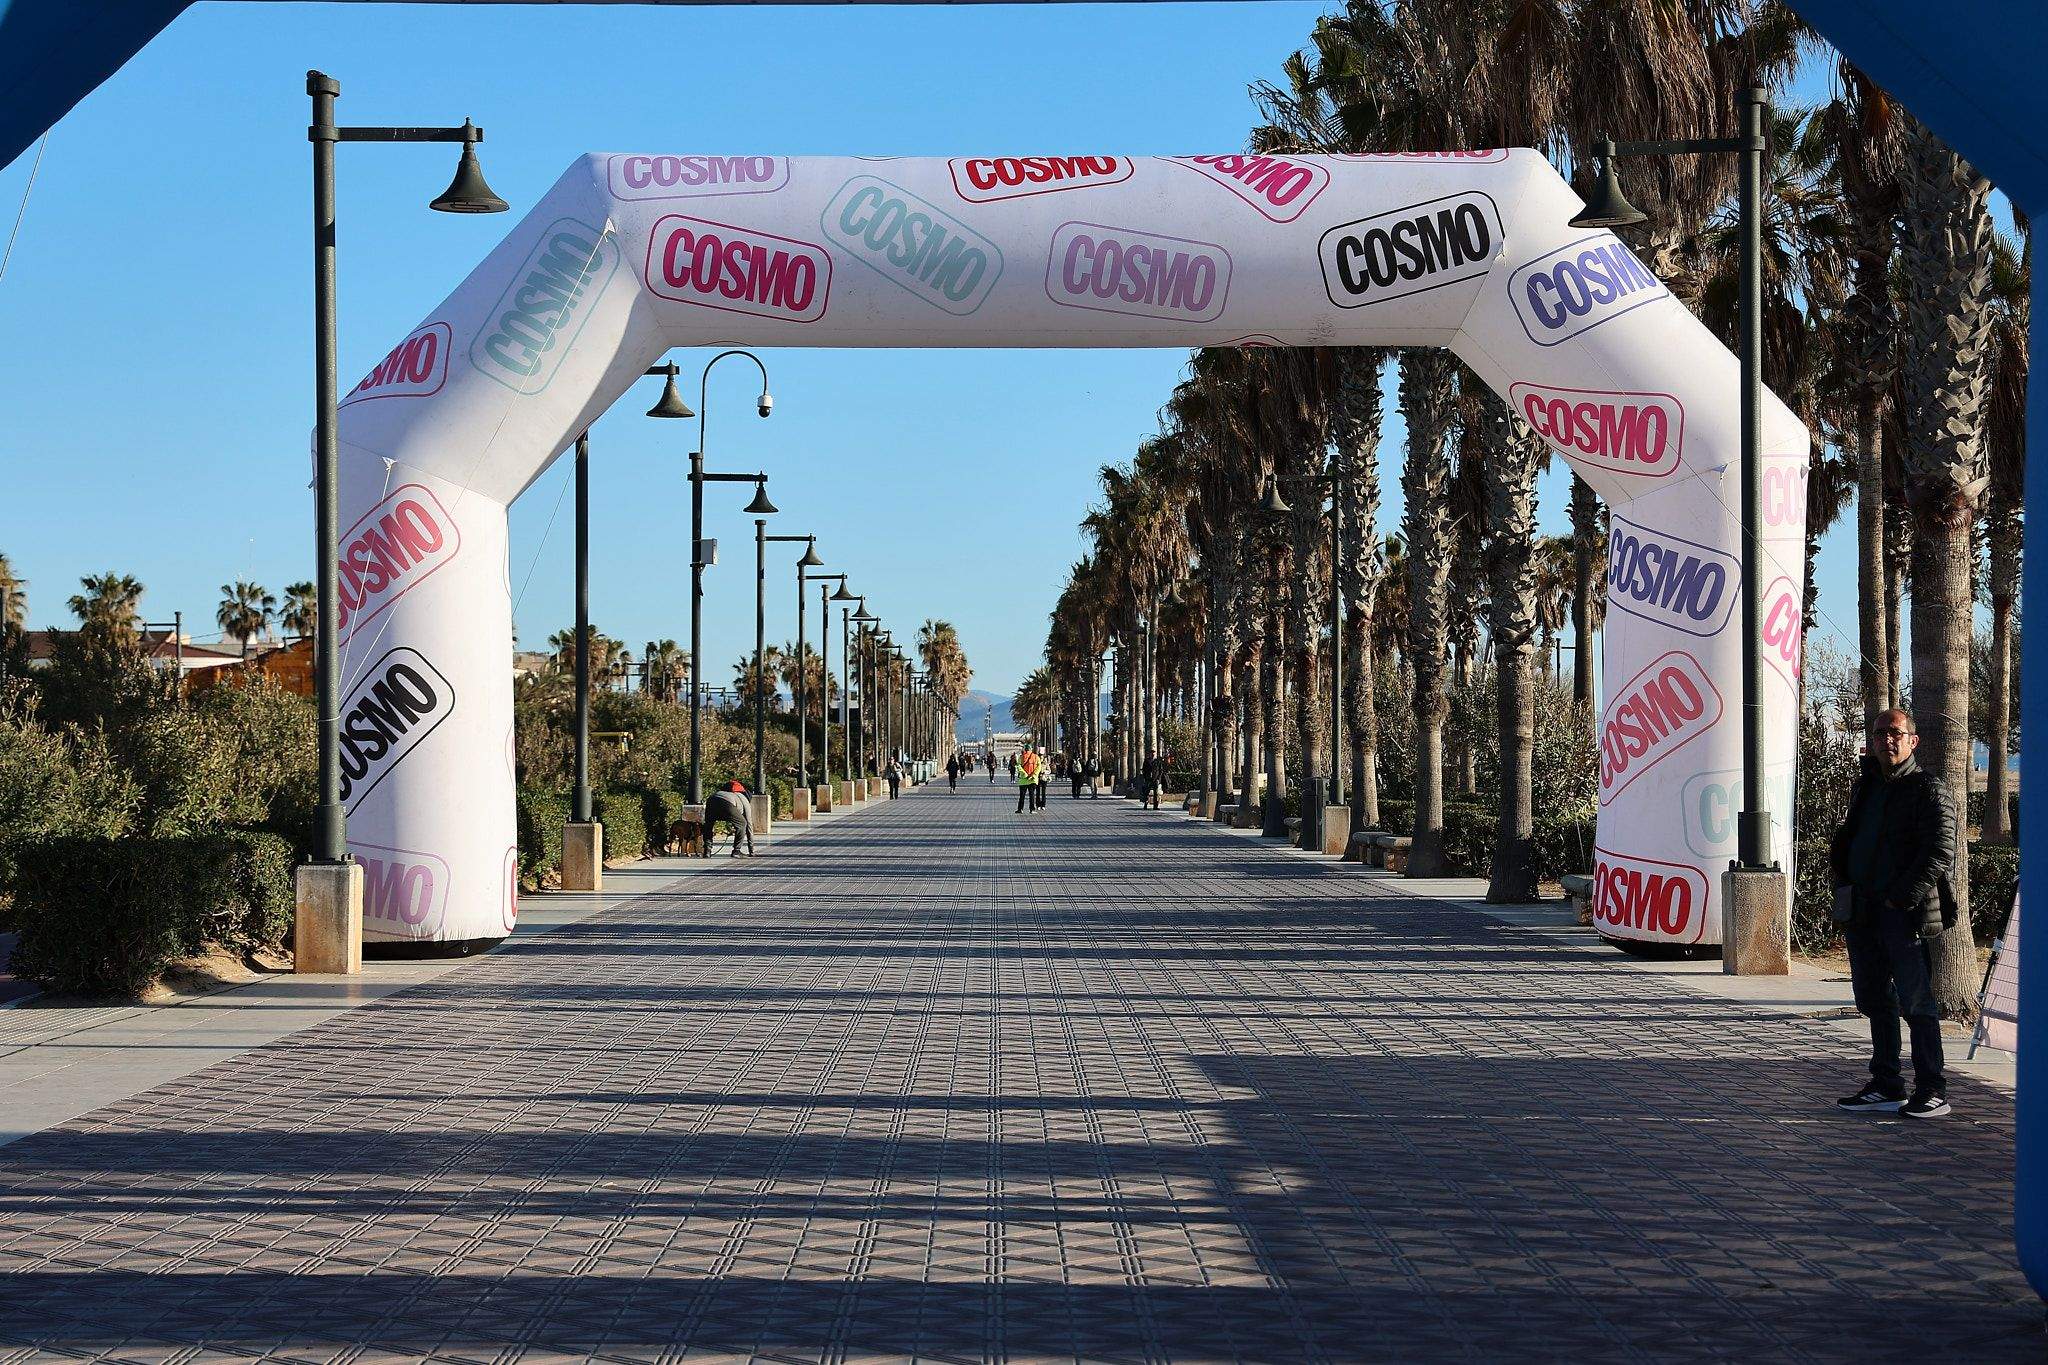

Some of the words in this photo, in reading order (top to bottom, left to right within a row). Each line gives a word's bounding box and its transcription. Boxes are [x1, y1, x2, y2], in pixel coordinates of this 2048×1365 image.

[623, 156, 775, 190] COSMO
[662, 228, 816, 311] COSMO
[839, 186, 986, 301] COSMO
[1063, 235, 1215, 311] COSMO
[1336, 203, 1490, 295] COSMO
[484, 232, 602, 376] COSMO
[1524, 394, 1667, 463] COSMO
[338, 500, 443, 630] OSMO
[1609, 528, 1725, 621] COSMO
[1594, 858, 1692, 935] OSMO
